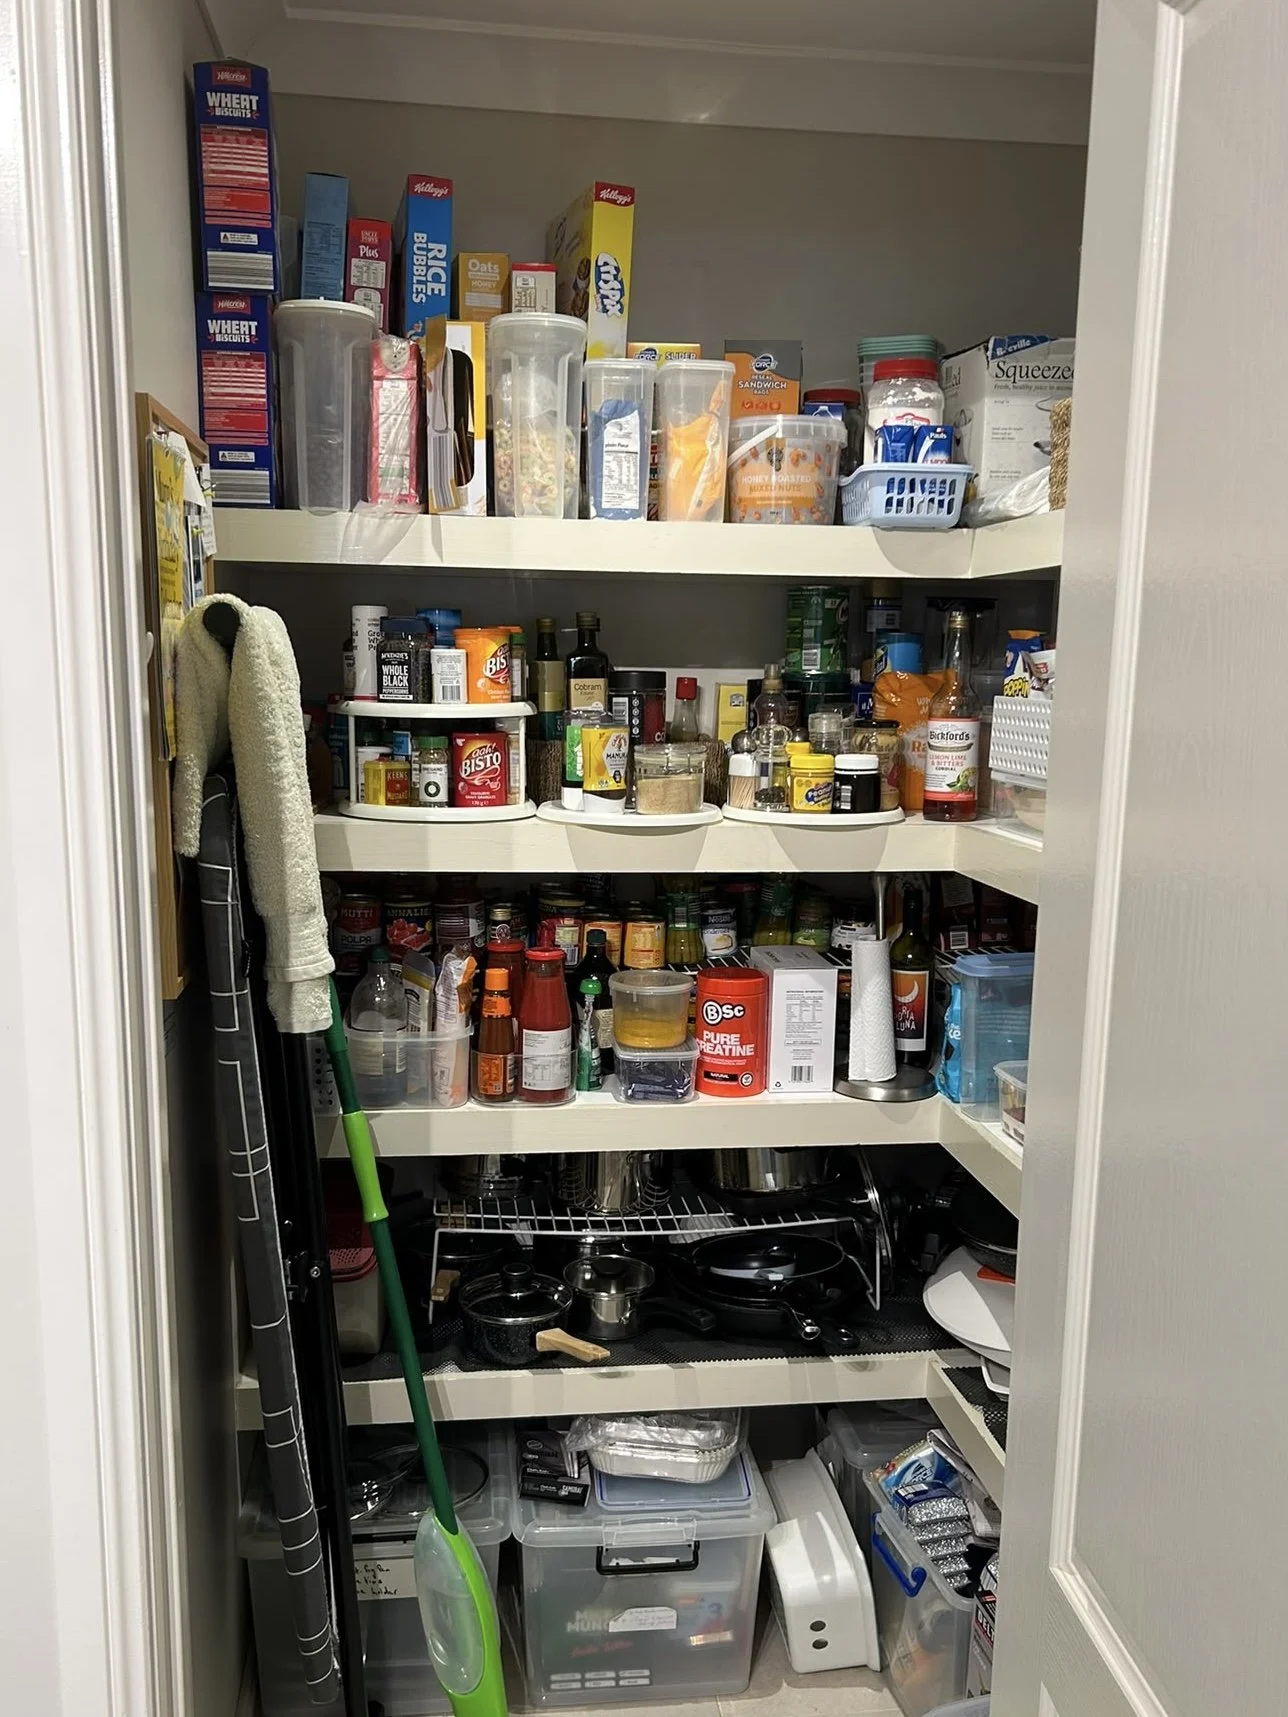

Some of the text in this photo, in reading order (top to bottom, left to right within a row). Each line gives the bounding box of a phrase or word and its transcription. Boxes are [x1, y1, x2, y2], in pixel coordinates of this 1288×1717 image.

[206, 92, 259, 110] WHEAT
[414, 181, 449, 197] Kellogg's
[599, 188, 632, 205] Kellogg's
[359, 245, 379, 258] Plus
[412, 232, 428, 304] BUBBLES
[427, 242, 447, 297] RICE
[468, 259, 500, 273] Oats
[471, 280, 497, 289] HONEY
[207, 319, 258, 336] WHEAT
[665, 352, 697, 361] SLIDER
[738, 380, 787, 389] SANDWICH
[382, 665, 408, 676] WHOLE
[486, 653, 510, 676] BIST
[382, 675, 409, 687] BLACK
[574, 683, 602, 691] Cobram
[929, 731, 970, 741] Bickford's
[461, 751, 501, 777] BISTO
[387, 907, 433, 917] ANNALIS
[341, 935, 373, 944] POLPA
[896, 1019, 916, 1032] LUNA
[703, 1030, 741, 1045] PURE
